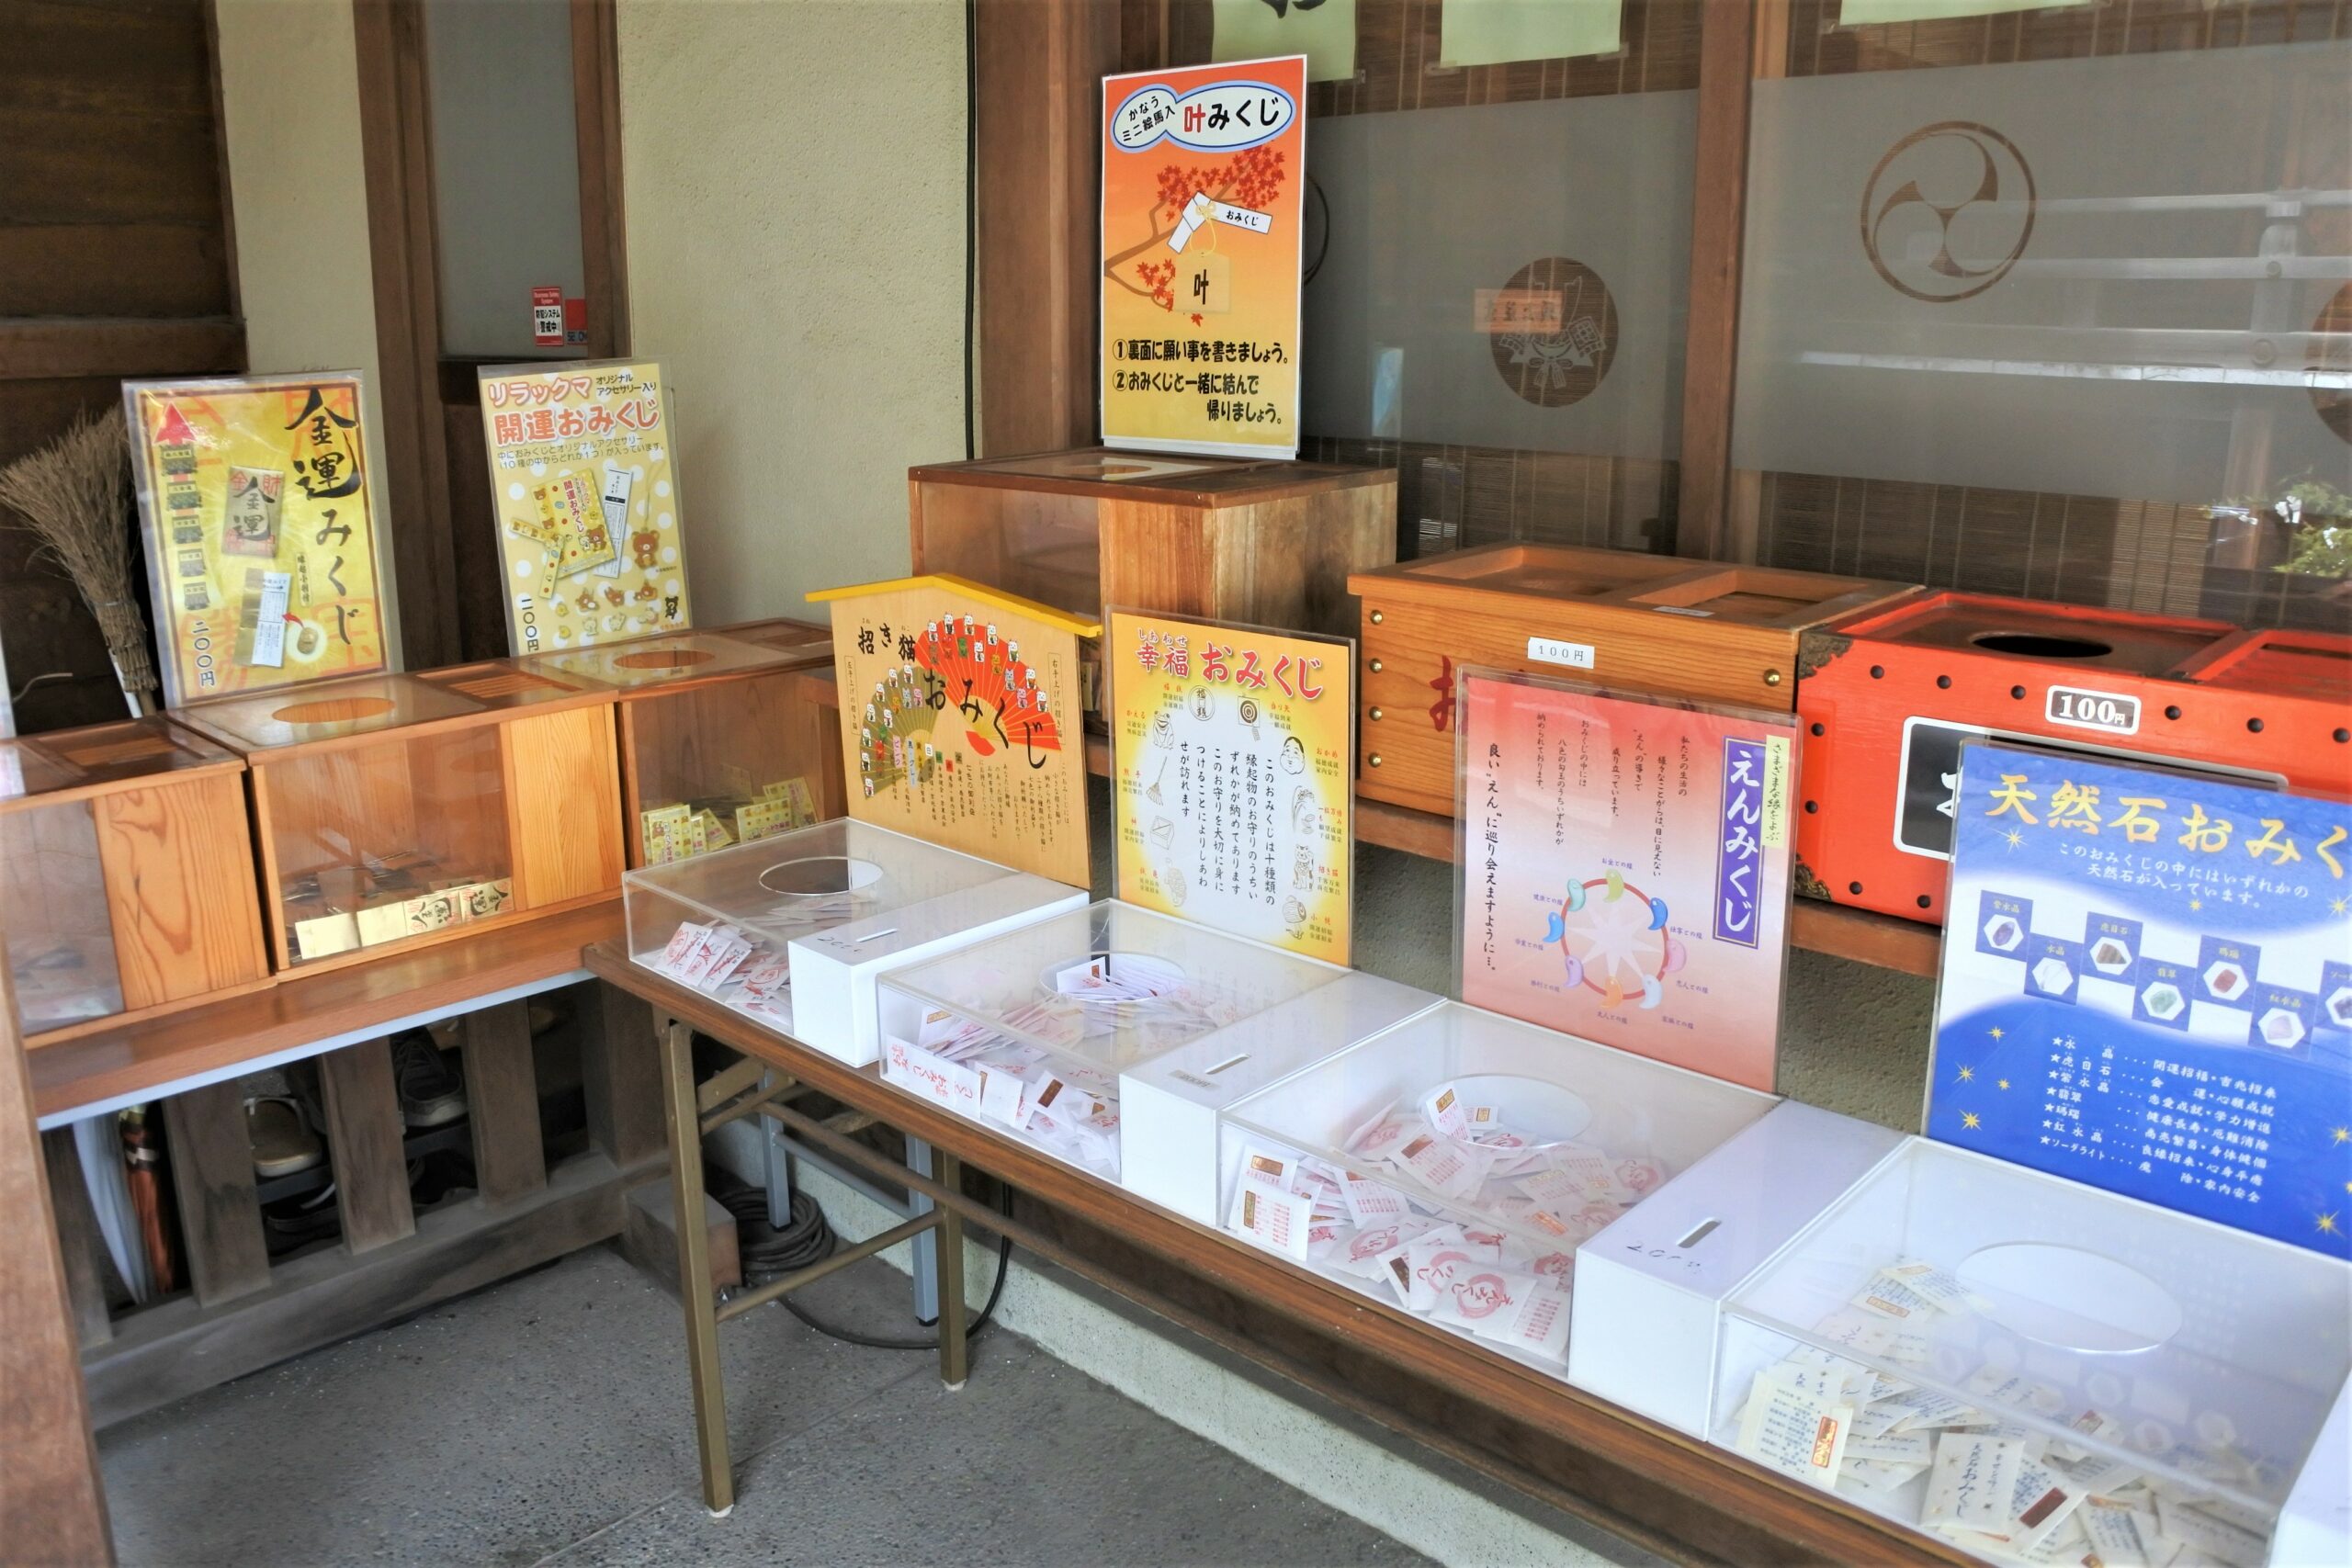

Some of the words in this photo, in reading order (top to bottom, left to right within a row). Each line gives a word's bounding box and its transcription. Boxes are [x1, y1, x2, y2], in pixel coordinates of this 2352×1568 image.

[1122, 105, 1176, 141] ミニ絵馬入
[1128, 96, 1159, 120] かなう
[1183, 96, 1280, 133] 叶みくじ
[1226, 209, 1260, 227] おみくじ
[1193, 269, 1209, 305] 叶
[488, 376, 594, 407] リラックマ
[595, 374, 634, 385] オリジナル
[596, 381, 657, 396] アクセサリー入り
[1206, 399, 1282, 425] 帰りましょう。
[493, 398, 661, 447] 開運おみくじ
[285, 387, 364, 646] 金運みくじ
[857, 622, 916, 662] 招き猫
[1138, 628, 1188, 647] しあわせ
[1136, 642, 1190, 678] 幸福
[1199, 641, 1323, 700] おみくじ
[922, 668, 1046, 770] おみくじ
[2059, 694, 2126, 726] 100円
[1180, 740, 1191, 818] せが訪れます
[1578, 719, 1589, 787] おみくじの中には
[1679, 735, 1690, 796] 私たちの生活の
[1196, 746, 1208, 888] つけることによりしあわ
[1213, 748, 1225, 893] このお守りを大切に身に
[1229, 750, 1241, 895] ずれかが納めてあります
[1246, 753, 1258, 899] 縁起物のお守りのうちい
[1264, 759, 1275, 906] このおみくじは十種類の
[1724, 750, 1760, 932] えんみくじ
[1984, 773, 2349, 880] 天然石おみく
[2060, 842, 2309, 898] このおみくじの中にはいずれかの
[2086, 863, 2261, 908] 天然石が入っています。
